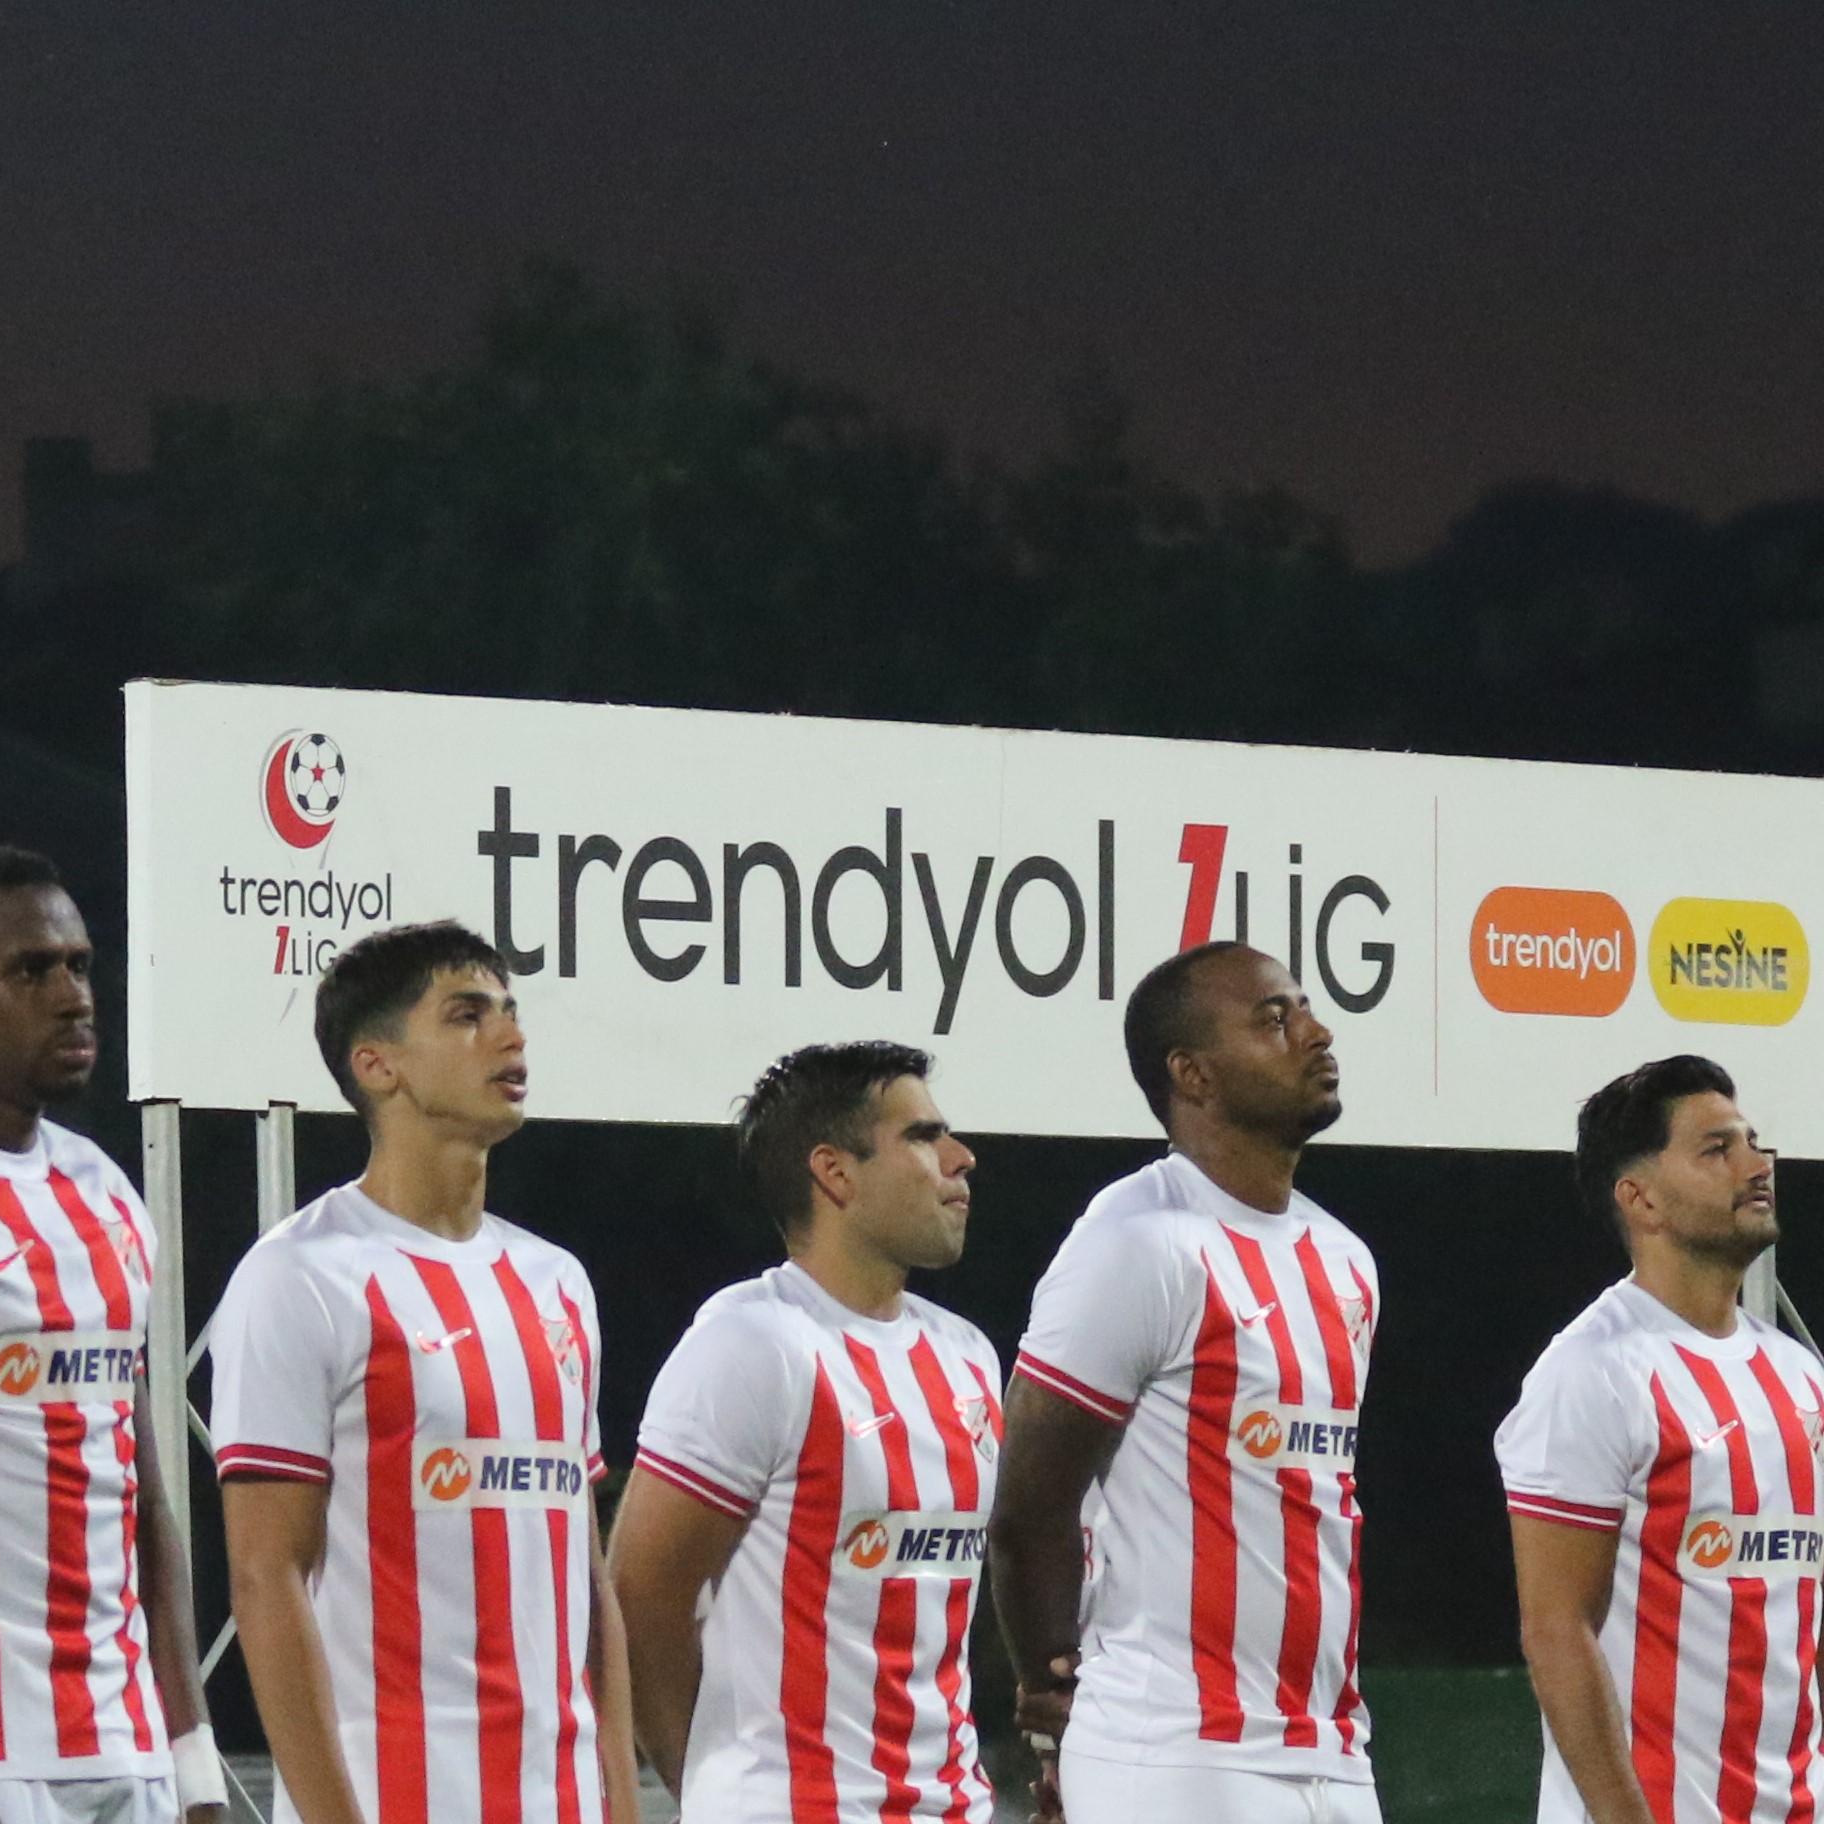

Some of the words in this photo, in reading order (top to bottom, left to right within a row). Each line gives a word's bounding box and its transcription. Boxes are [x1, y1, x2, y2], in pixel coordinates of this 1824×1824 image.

[220, 866, 391, 930] trendyol
[478, 786, 1115, 1035] trendyol
[1486, 923, 1621, 980] trendyol
[47, 1349, 136, 1385] METR
[1287, 1421, 1360, 1458] METR
[480, 1455, 582, 1497] METRO
[1737, 1529, 1824, 1563] METR
